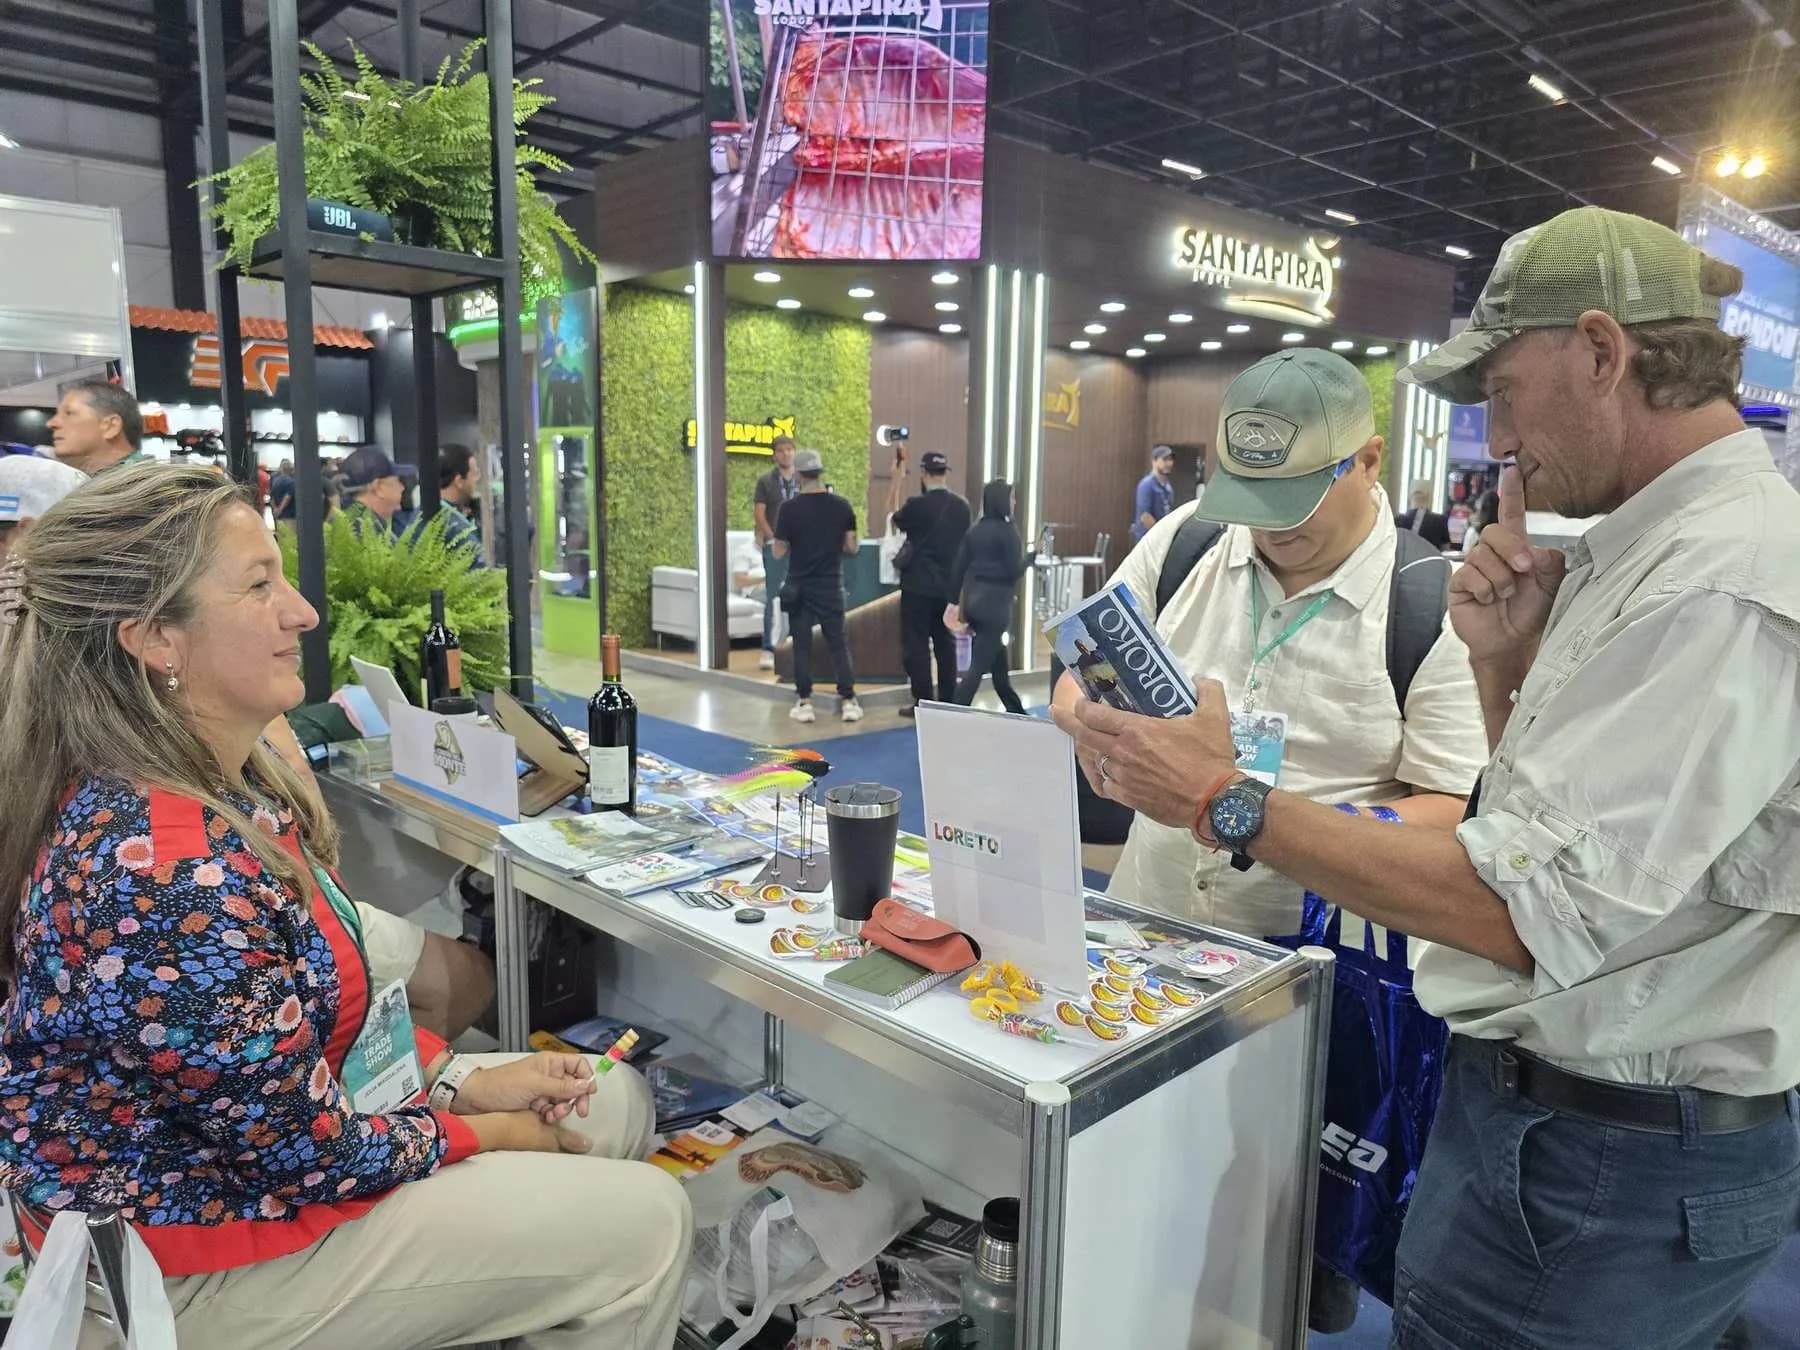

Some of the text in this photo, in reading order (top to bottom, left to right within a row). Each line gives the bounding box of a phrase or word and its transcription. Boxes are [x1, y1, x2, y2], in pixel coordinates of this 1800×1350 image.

[324, 206, 357, 230] JBL
[1180, 227, 1325, 291] SANTAPIRA
[934, 821, 999, 855] LORETO
[364, 1032, 393, 1060] TRADE
[366, 1043, 393, 1072] SHOW
